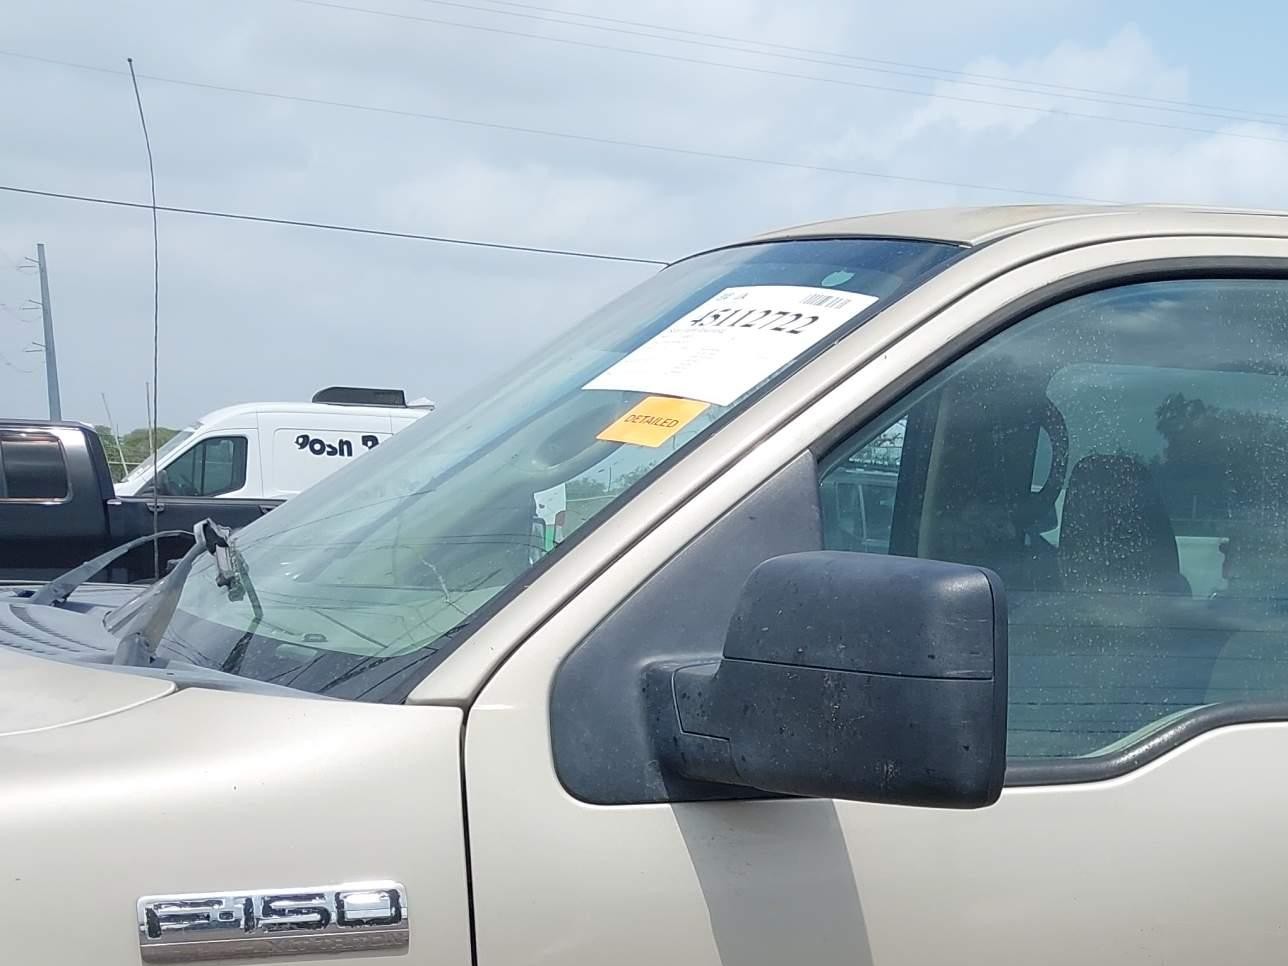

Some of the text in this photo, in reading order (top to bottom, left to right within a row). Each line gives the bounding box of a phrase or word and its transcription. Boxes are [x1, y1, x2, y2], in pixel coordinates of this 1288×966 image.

[690, 308, 820, 335] 45112722
[623, 414, 680, 428] DETAILED
[144, 888, 402, 939] F-150
